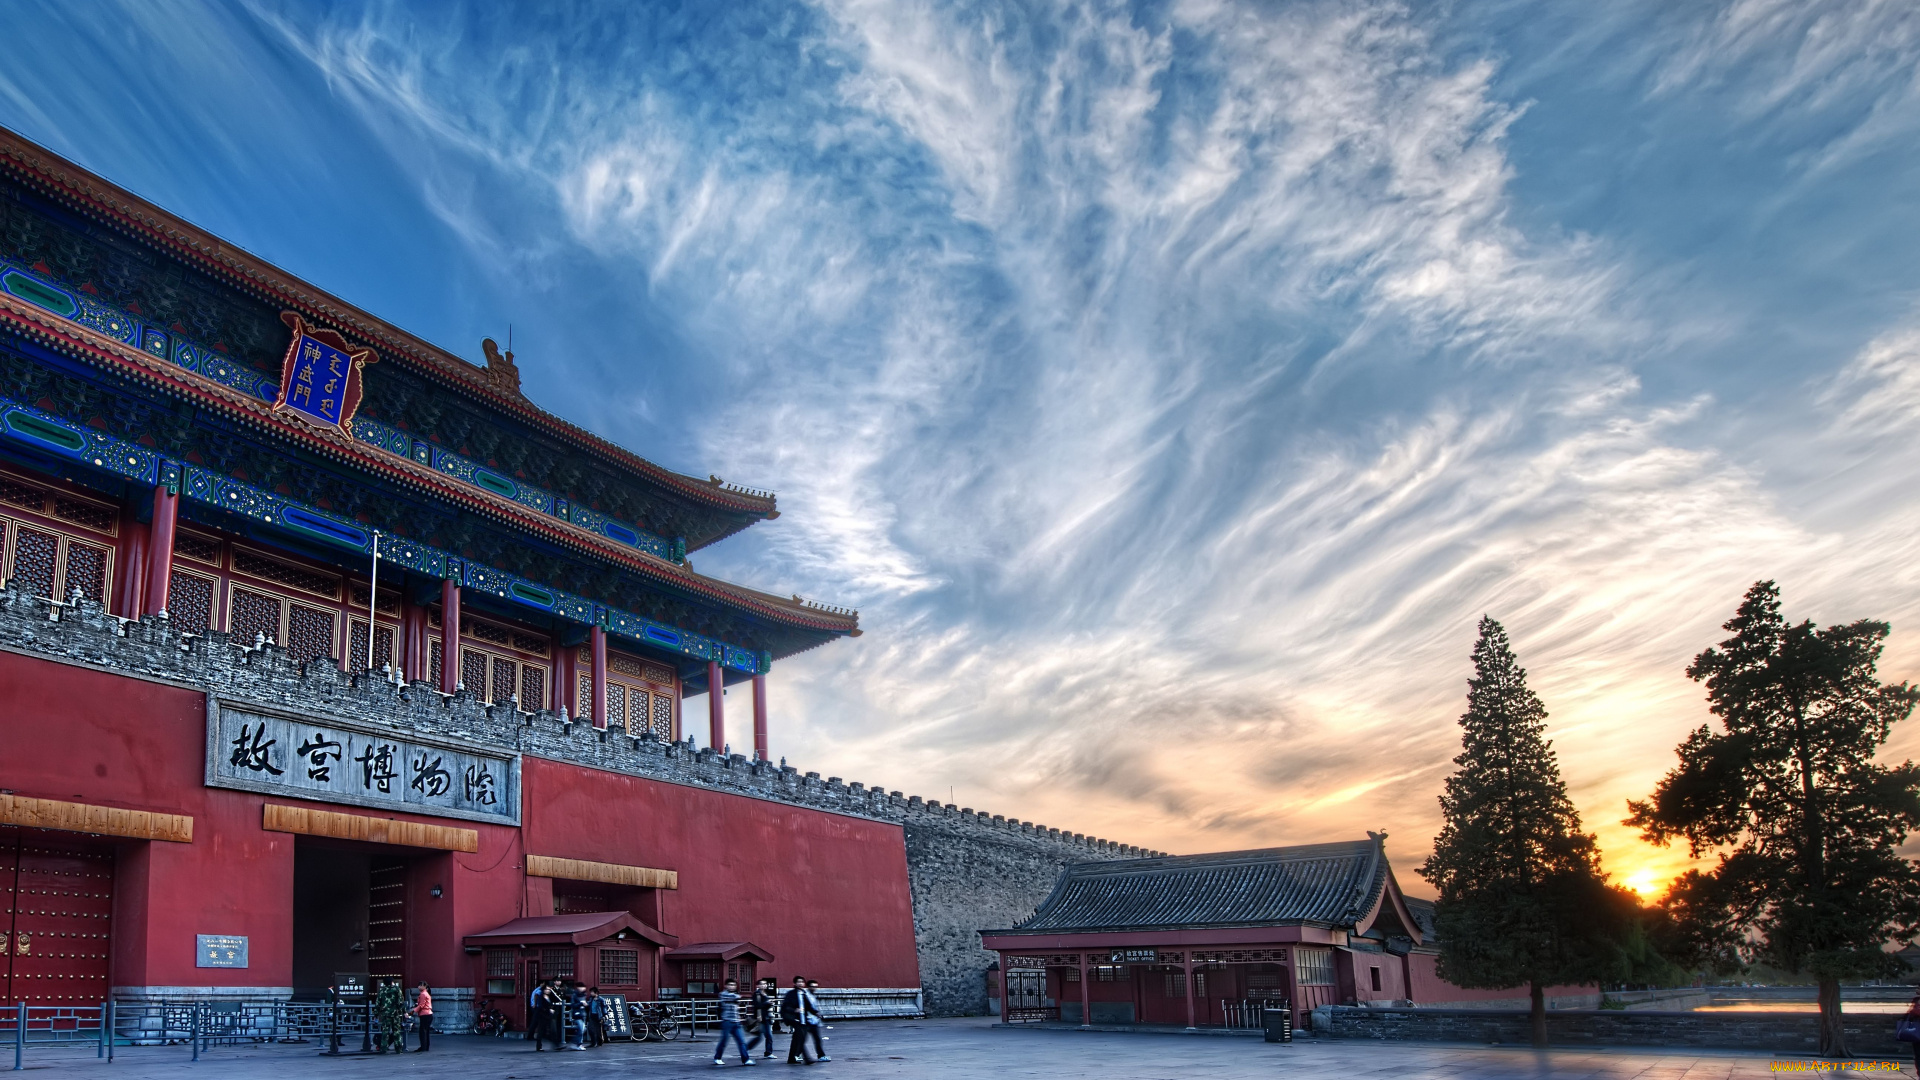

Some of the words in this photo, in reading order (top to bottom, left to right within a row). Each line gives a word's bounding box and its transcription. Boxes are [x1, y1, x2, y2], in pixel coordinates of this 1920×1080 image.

[294, 342, 322, 407] 神武門
[230, 722, 497, 805] 故宫博物院
